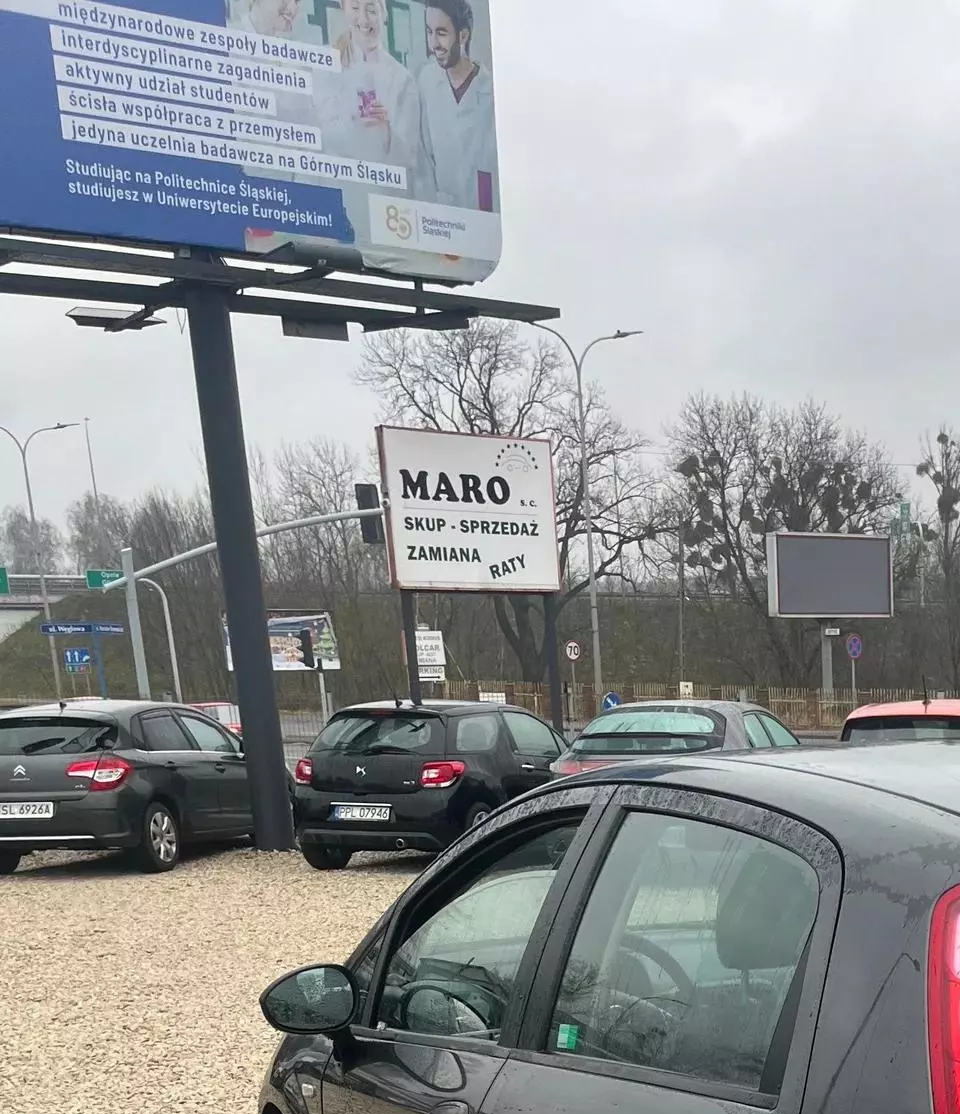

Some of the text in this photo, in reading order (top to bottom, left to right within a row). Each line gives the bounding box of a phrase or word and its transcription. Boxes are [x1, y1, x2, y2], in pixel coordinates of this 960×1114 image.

[58, 3, 333, 66] międzynarodowe zespoły badawcze
[61, 29, 306, 88] interdyscyplinarne zagadnienia
[66, 62, 269, 110] aktywny udział studentów
[69, 91, 316, 144] ścisła współpraca z przemysłem
[72, 120, 401, 185] jedyna uczelnia badawcza na Górnym Śląsku
[65, 158, 292, 206] Studiując na Politechnice Śląskiej,
[68, 181, 333, 227] studiujesz w Uniwersytecie Europejskim!
[399, 469, 511, 505] MARO
[404, 516, 446, 532] SKUP
[460, 519, 539, 537] SPRZEDAŻ
[406, 545, 482, 563] ZAMIANA
[489, 554, 526, 579] RATY
[568, 645, 579, 657] 70
[1, 804, 51, 815] SL 6926A
[340, 807, 388, 819] PPL 07946
